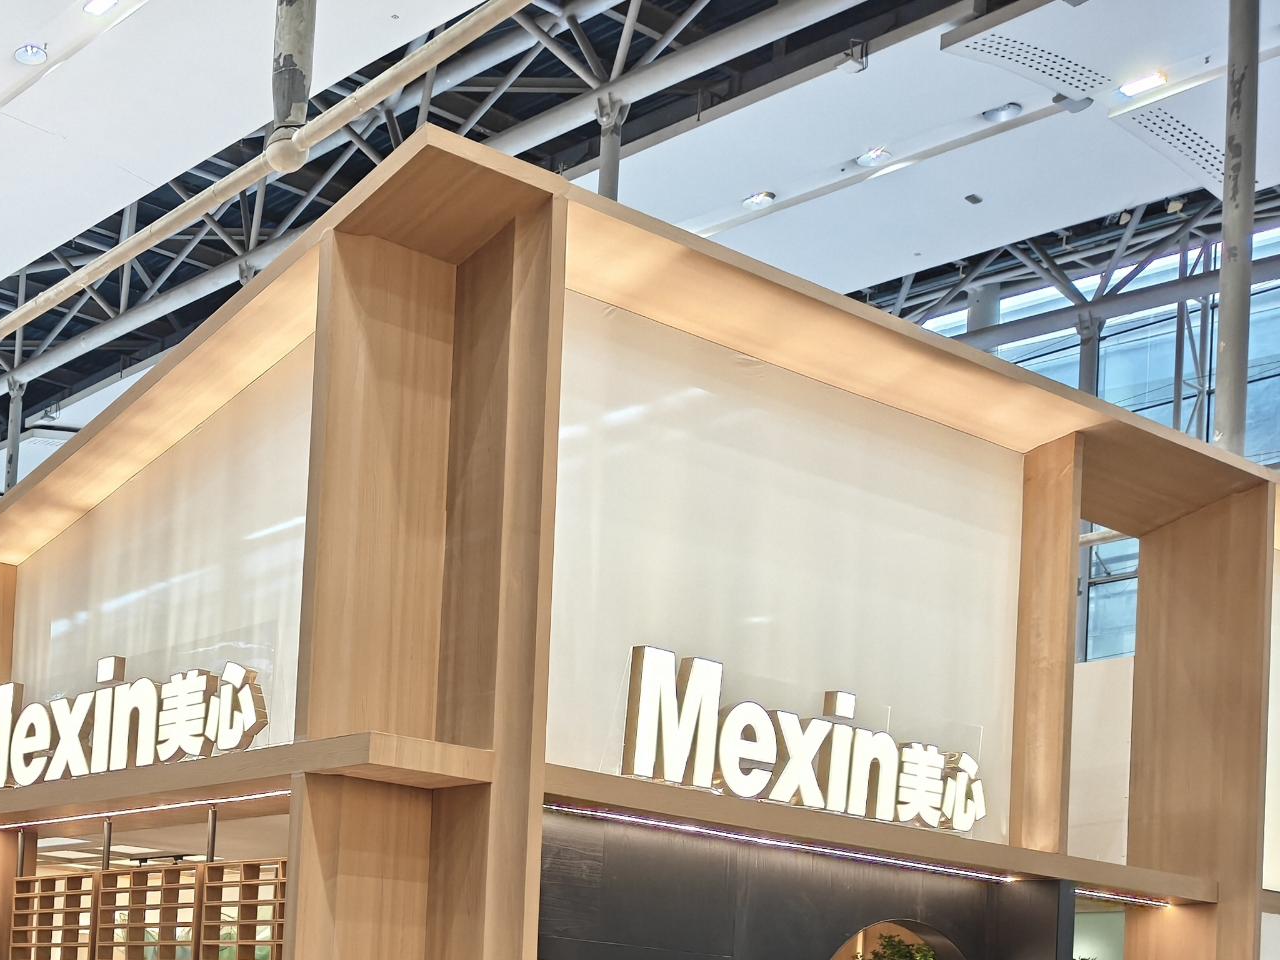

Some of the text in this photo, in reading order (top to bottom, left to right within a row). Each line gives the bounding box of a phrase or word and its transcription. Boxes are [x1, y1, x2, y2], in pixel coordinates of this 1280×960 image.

[156, 660, 266, 762] 美心
[621, 645, 986, 832] Mexin 美心
